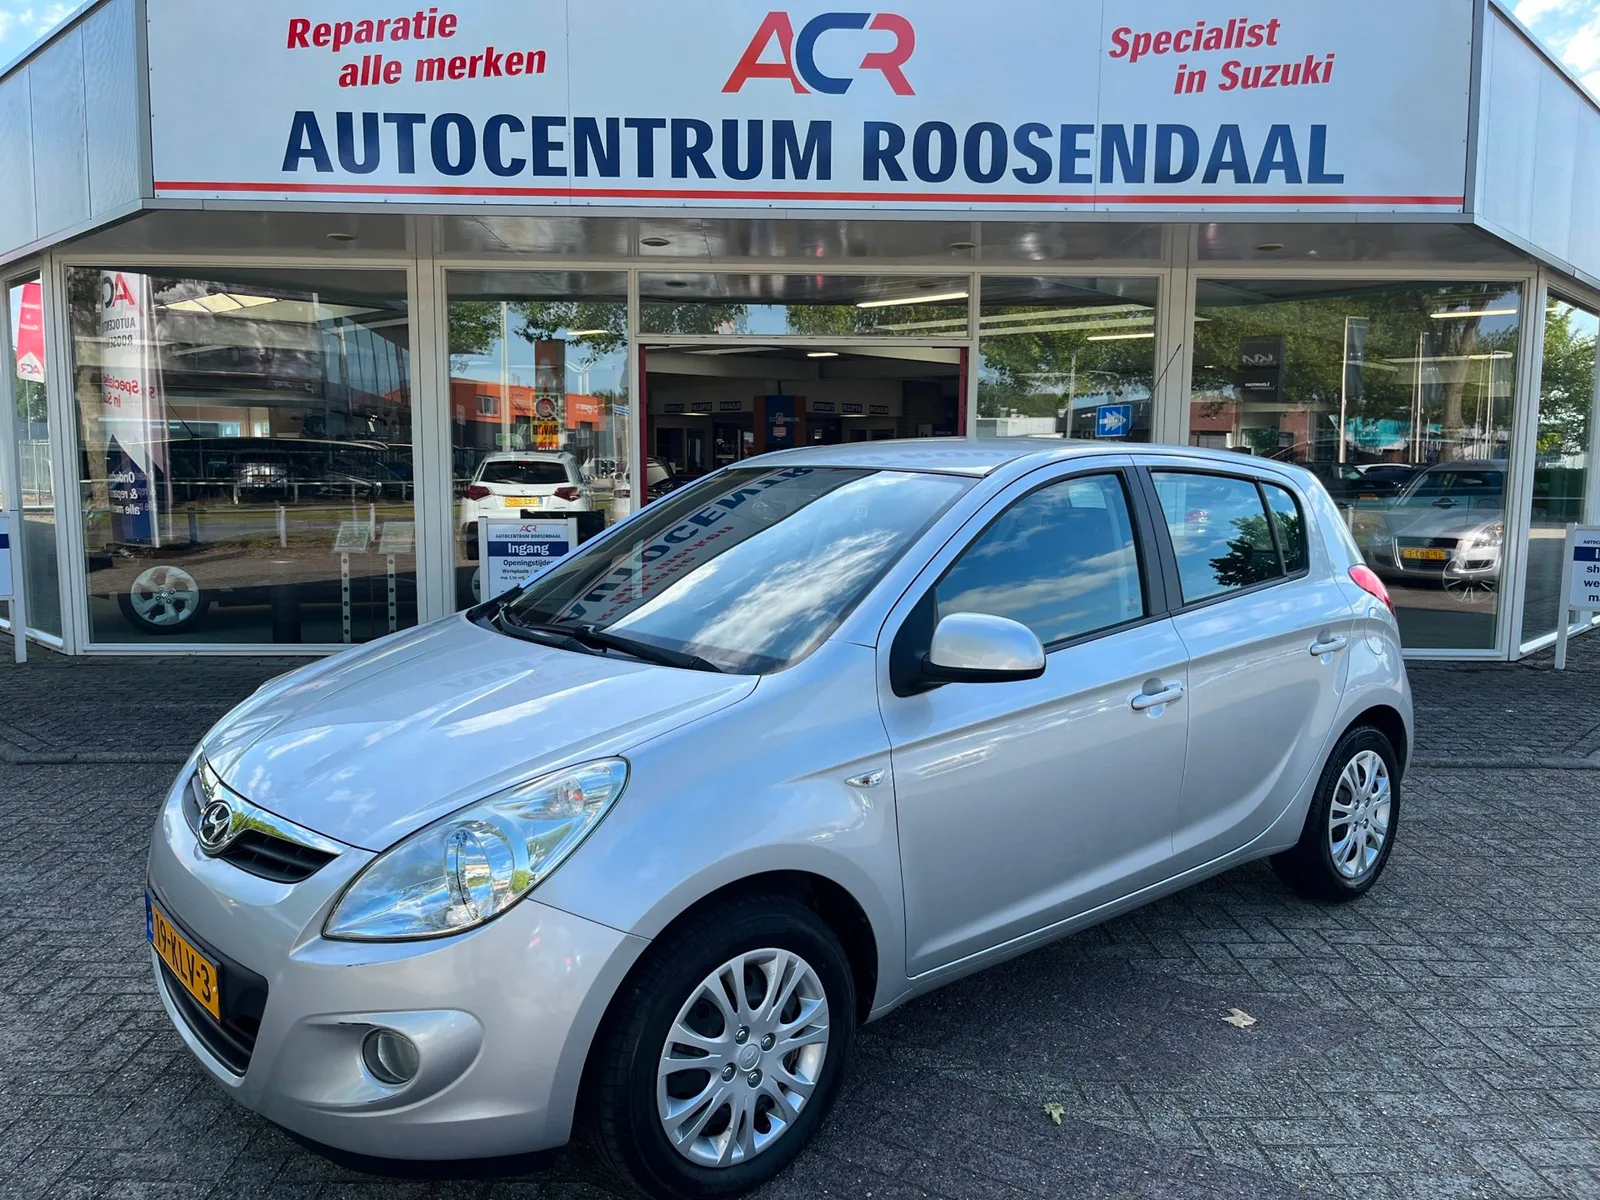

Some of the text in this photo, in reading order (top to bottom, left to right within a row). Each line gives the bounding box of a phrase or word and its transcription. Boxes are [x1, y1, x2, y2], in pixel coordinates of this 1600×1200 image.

[286, 7, 458, 52] Reparatie
[1108, 17, 1281, 63] Specialist
[338, 49, 548, 88] alle merken
[720, 11, 916, 96] ACR
[1173, 53, 1336, 96] in Suzuki
[281, 110, 1345, 185] AUTOCENTRUM ROOSENDAAL
[508, 543, 549, 556] Ingang
[520, 524, 537, 532] ACR
[155, 912, 212, 1004] 19-KLV-3
